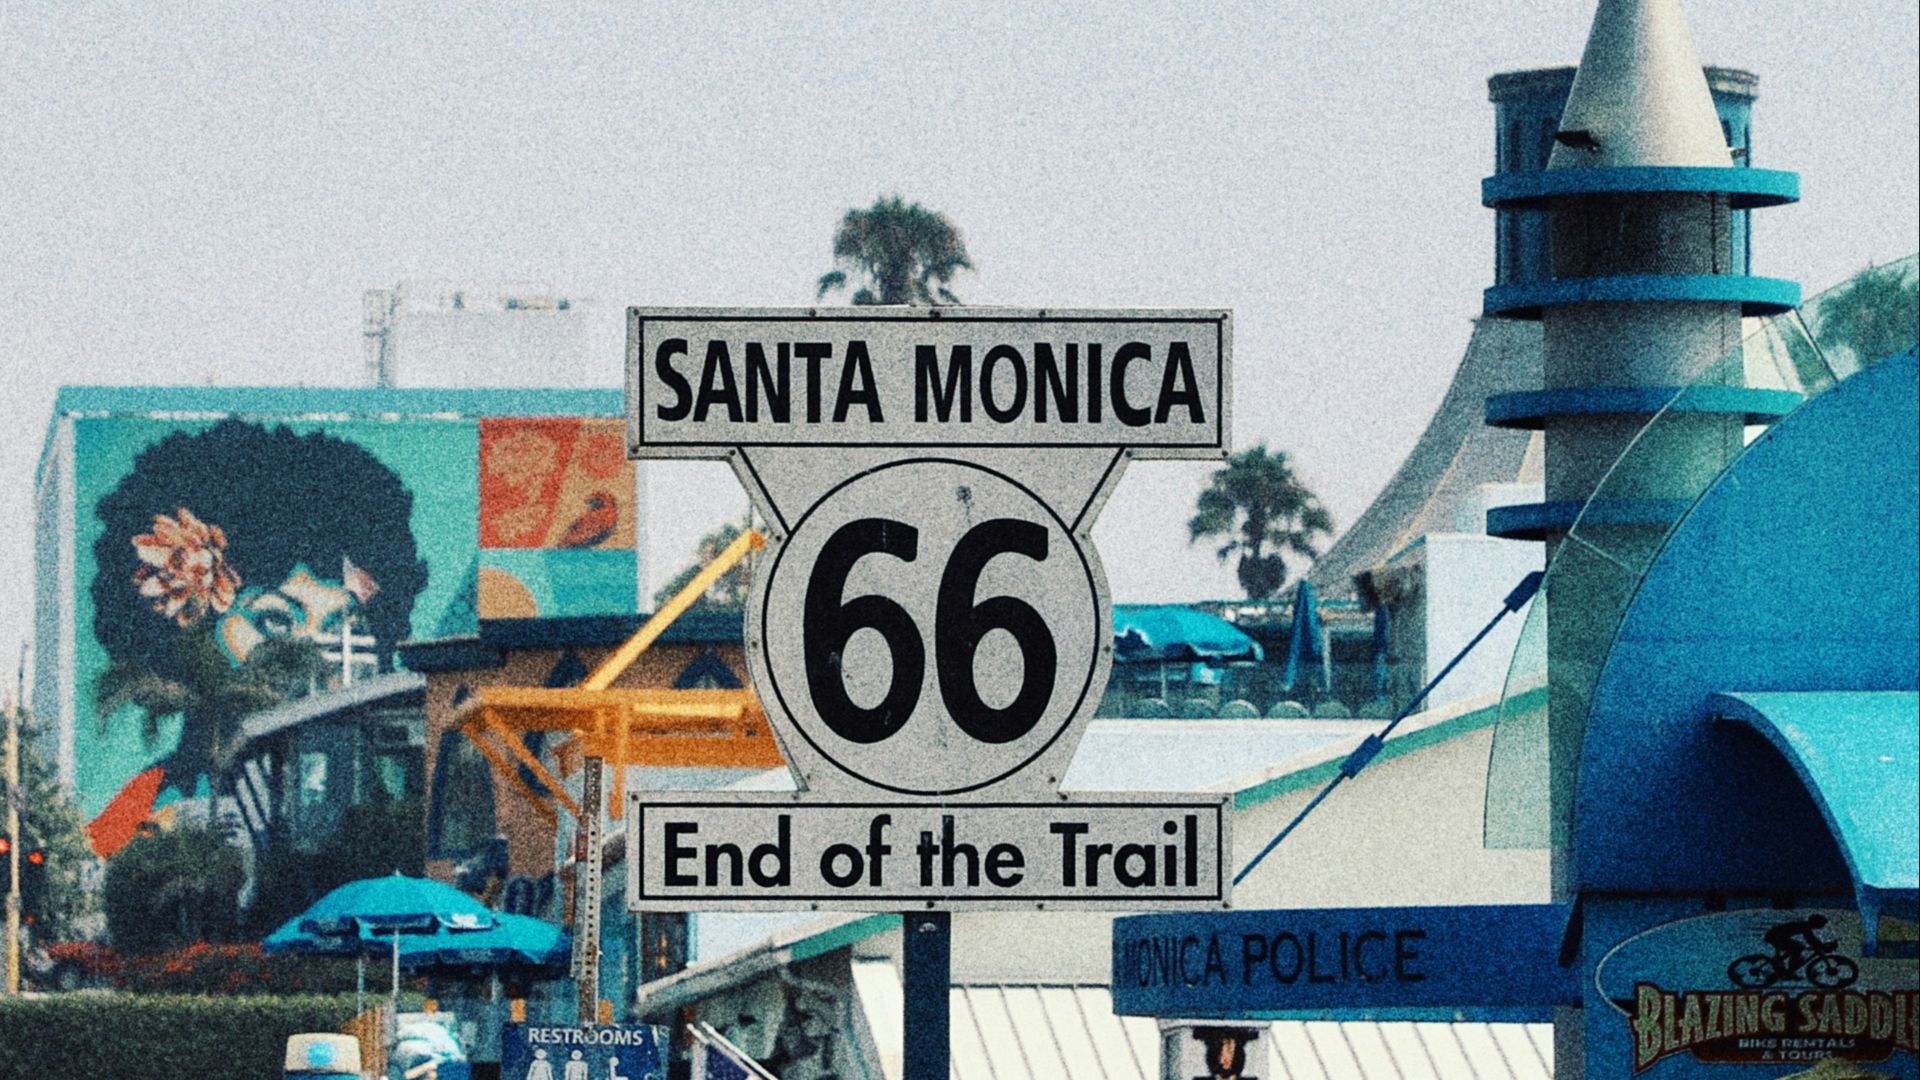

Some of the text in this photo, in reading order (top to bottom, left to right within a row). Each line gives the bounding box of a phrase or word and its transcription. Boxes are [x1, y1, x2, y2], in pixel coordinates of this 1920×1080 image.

[655, 338, 1206, 427] SANTA MONICA
[803, 517, 1058, 744] 66
[664, 814, 1198, 887] End of the Trail
[1243, 928, 1427, 985] POLICE
[528, 1026, 644, 1047] RESTROOMS
[1633, 984, 1786, 1067] BLAZING
[1737, 1038, 1856, 1049] BIKE RENTALS
